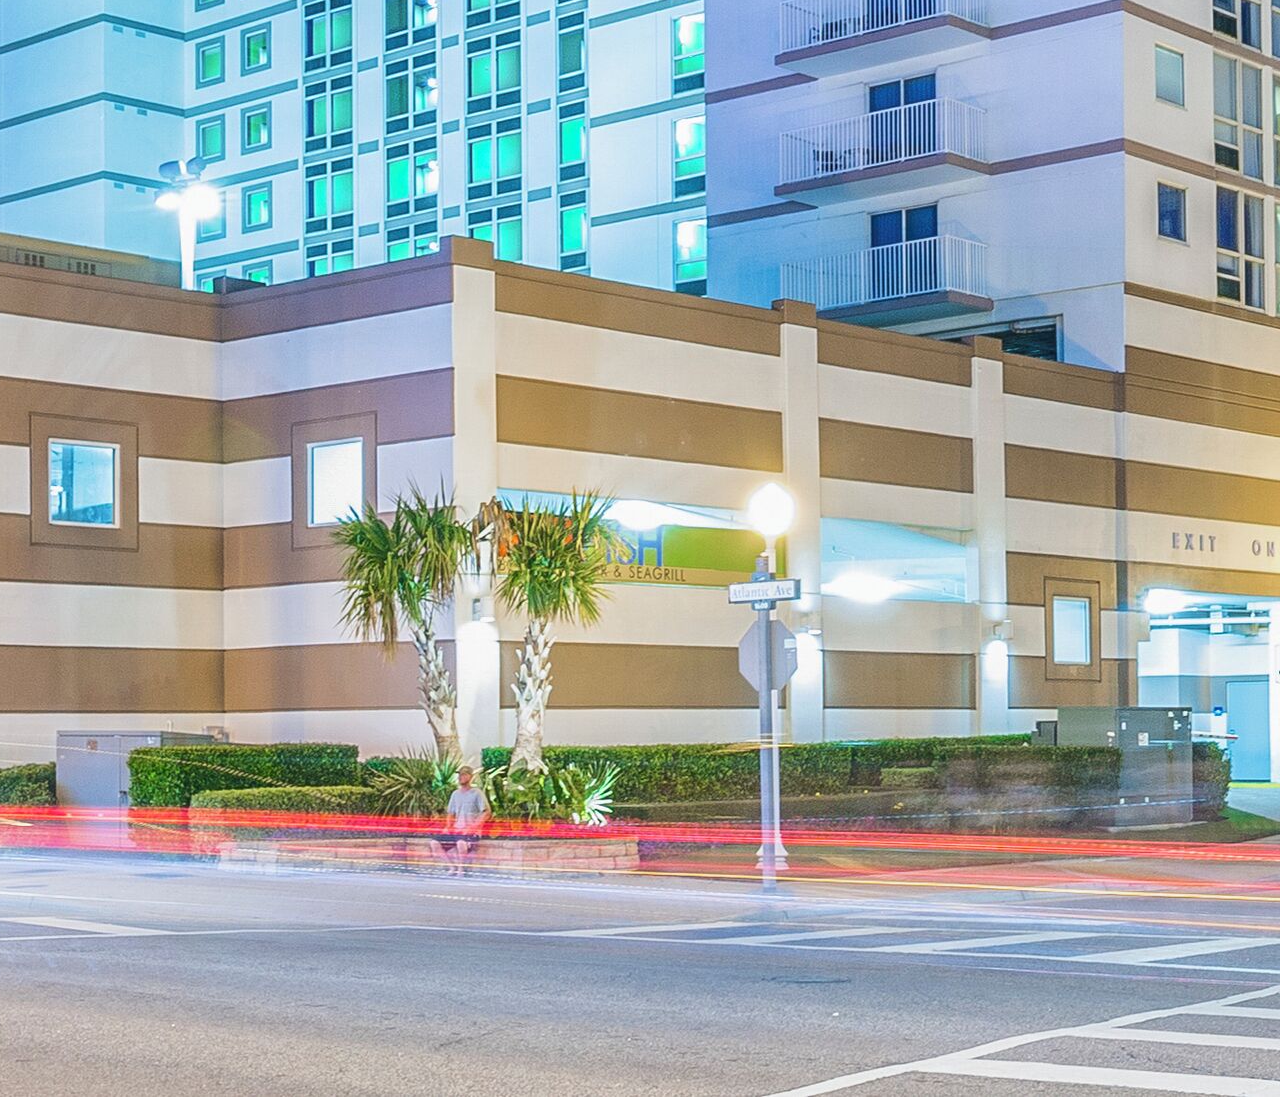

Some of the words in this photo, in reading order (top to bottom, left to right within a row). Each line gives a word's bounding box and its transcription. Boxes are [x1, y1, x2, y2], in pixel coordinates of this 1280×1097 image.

[1171, 532, 1217, 552] EXIT
[628, 565, 687, 582] SEAGRILL
[731, 585, 770, 599] Atlantic
[774, 584, 793, 596] Ave
